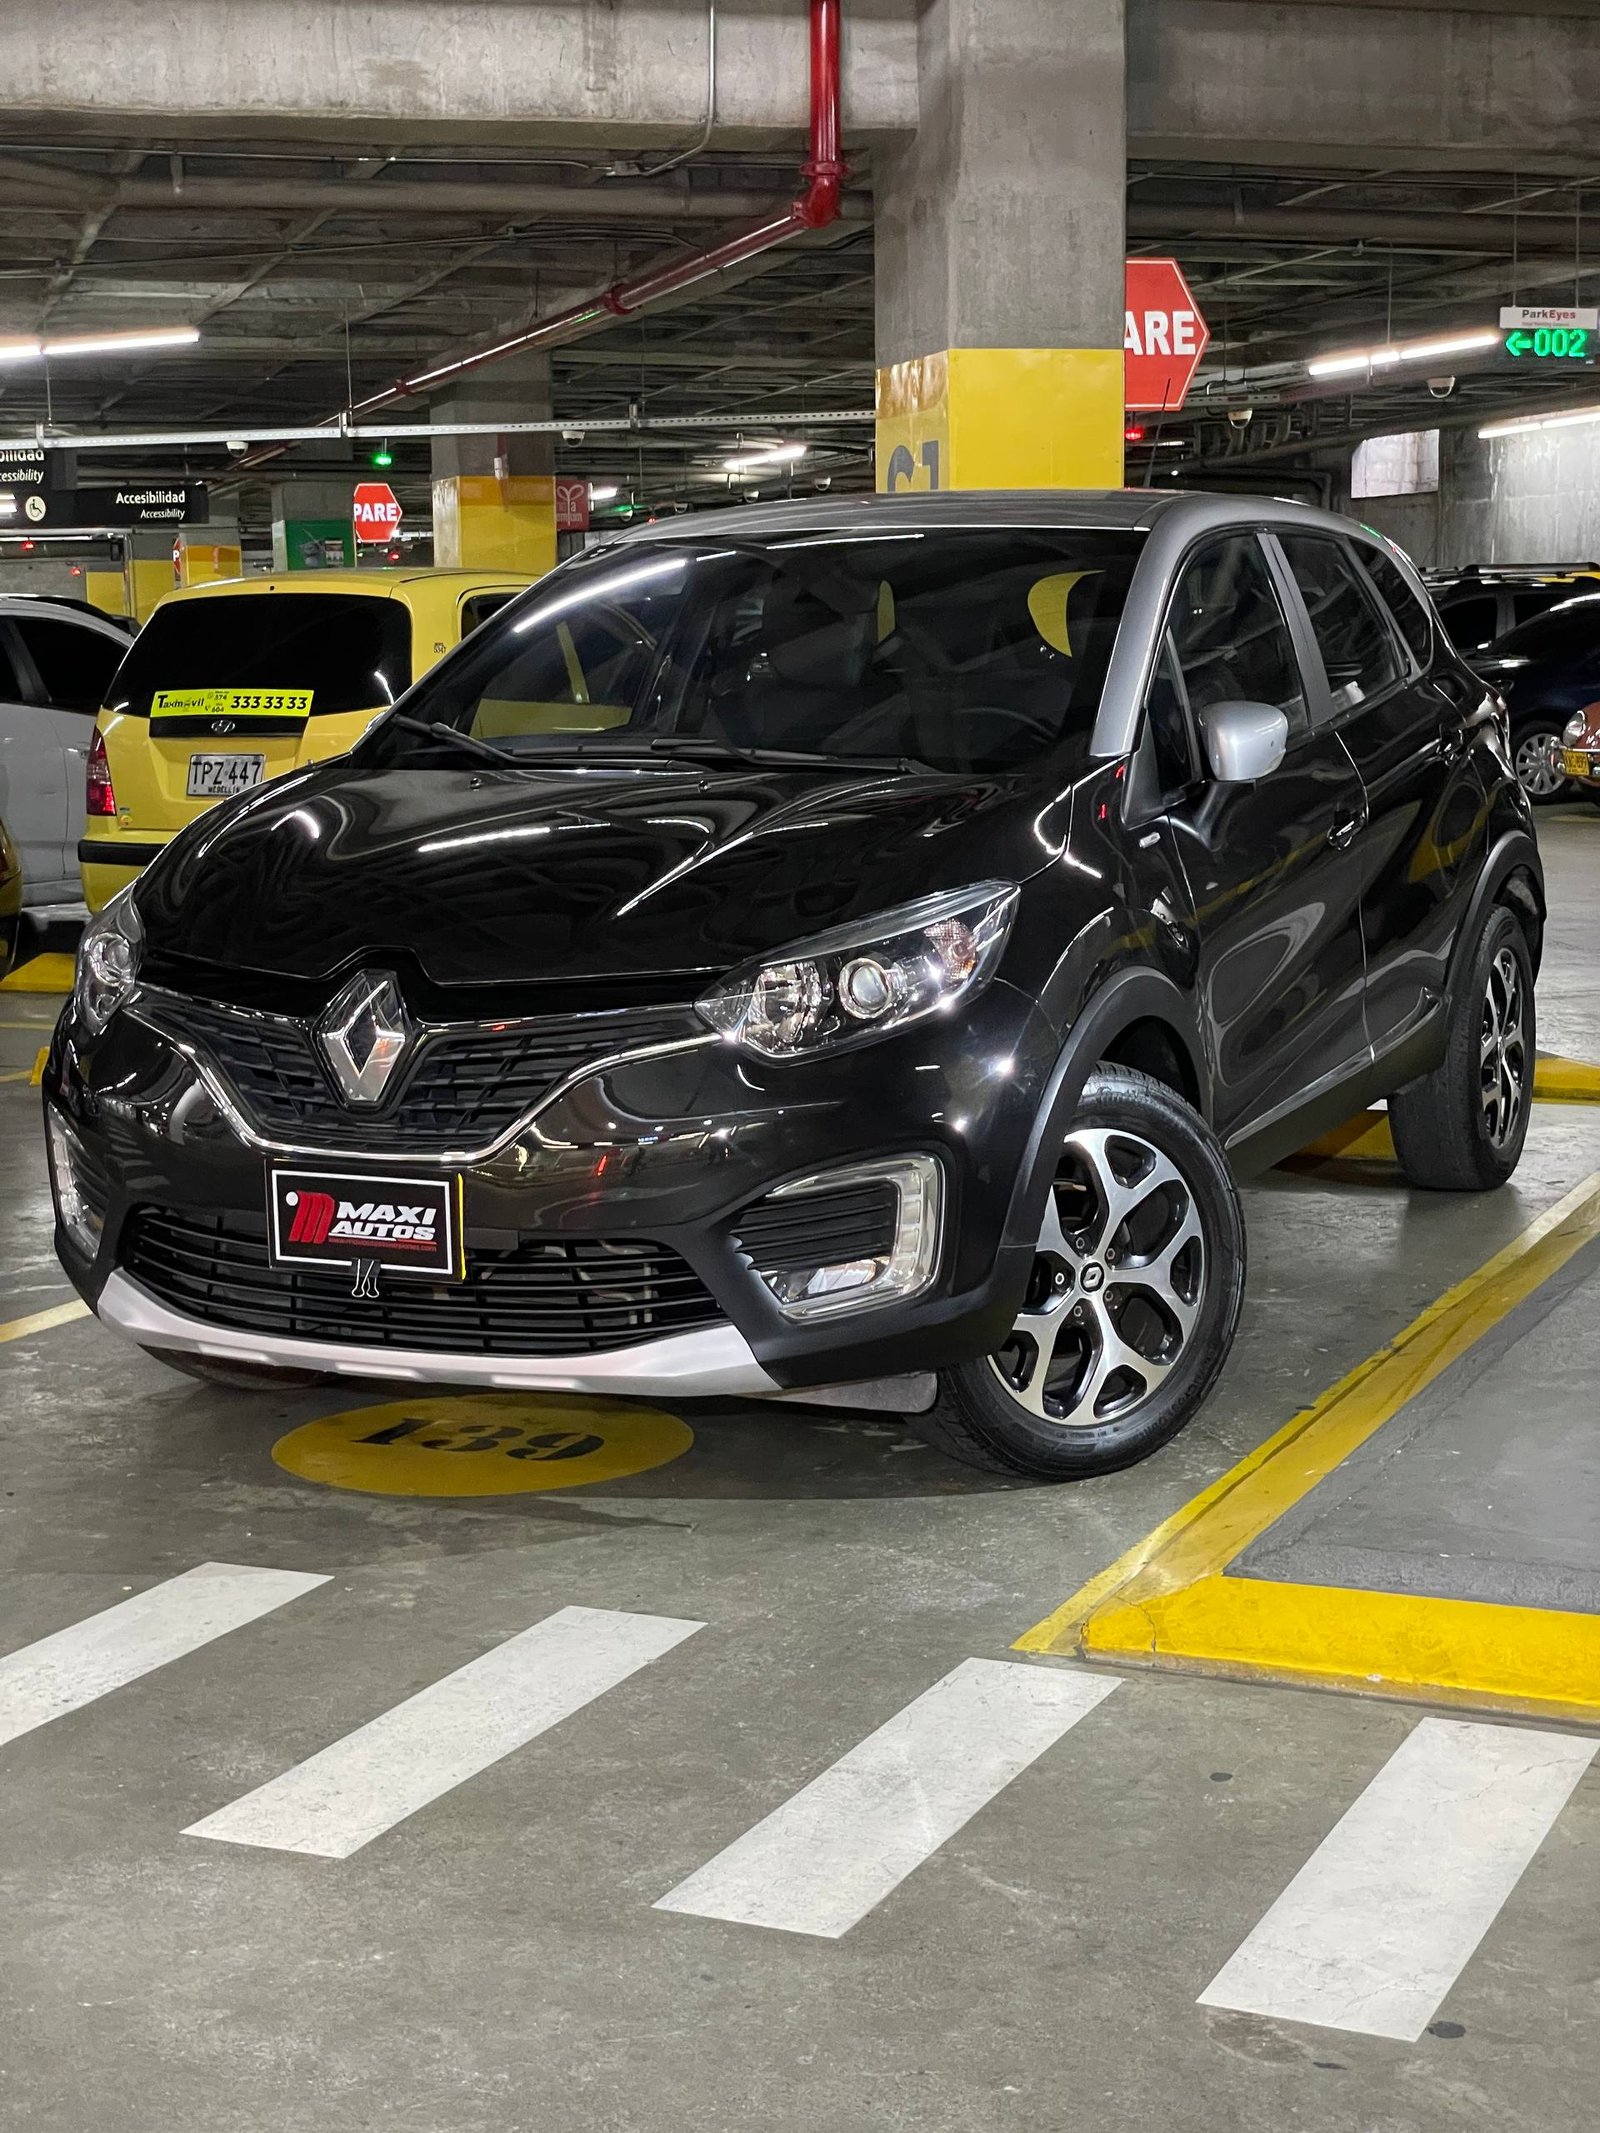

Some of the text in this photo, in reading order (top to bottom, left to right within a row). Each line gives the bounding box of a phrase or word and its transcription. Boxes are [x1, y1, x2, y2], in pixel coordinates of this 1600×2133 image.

[1522, 309, 1576, 321] ParkEyes
[1124, 310, 1196, 356] ARE
[1534, 329, 1586, 357] 002
[0, 468, 44, 485] cessibility
[115, 490, 186, 505] Accesibilidad
[140, 508, 186, 520] Accessibility
[354, 502, 398, 522] PARE
[336, 1201, 437, 1225] MAXI
[331, 1222, 436, 1241] AUTOS
[350, 1418, 606, 1462] 139
